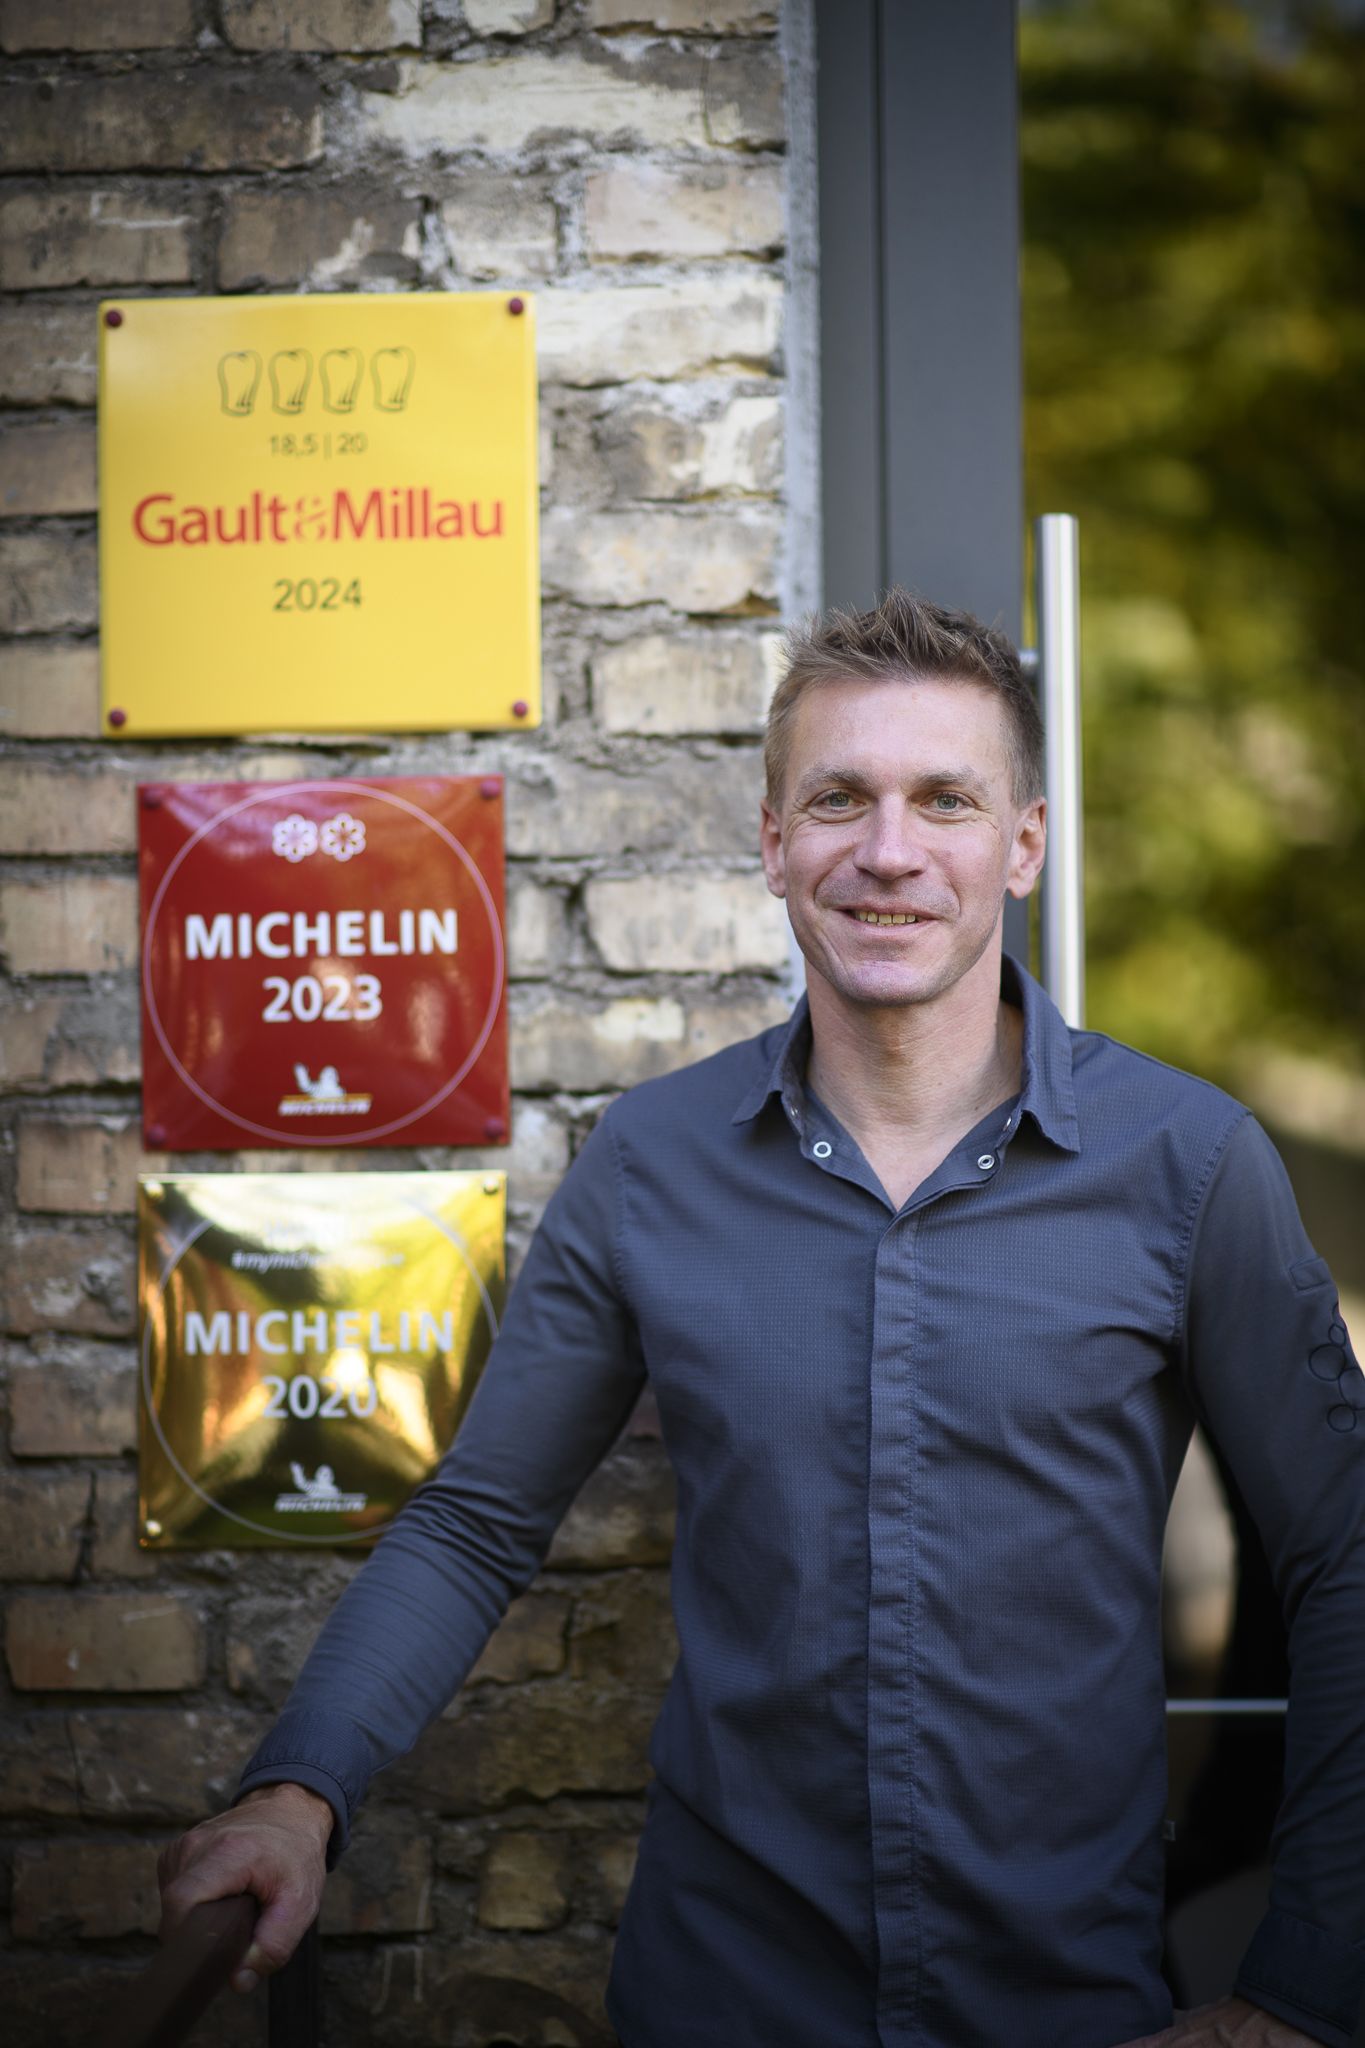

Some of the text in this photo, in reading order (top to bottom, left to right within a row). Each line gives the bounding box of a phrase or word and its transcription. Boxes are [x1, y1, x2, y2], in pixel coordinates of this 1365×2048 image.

[272, 577, 364, 612] 2024
[185, 908, 458, 960] MICHELIN
[262, 973, 383, 1023] 2023
[184, 1310, 455, 1356] MICHELIN
[261, 1374, 378, 1419] 2020
